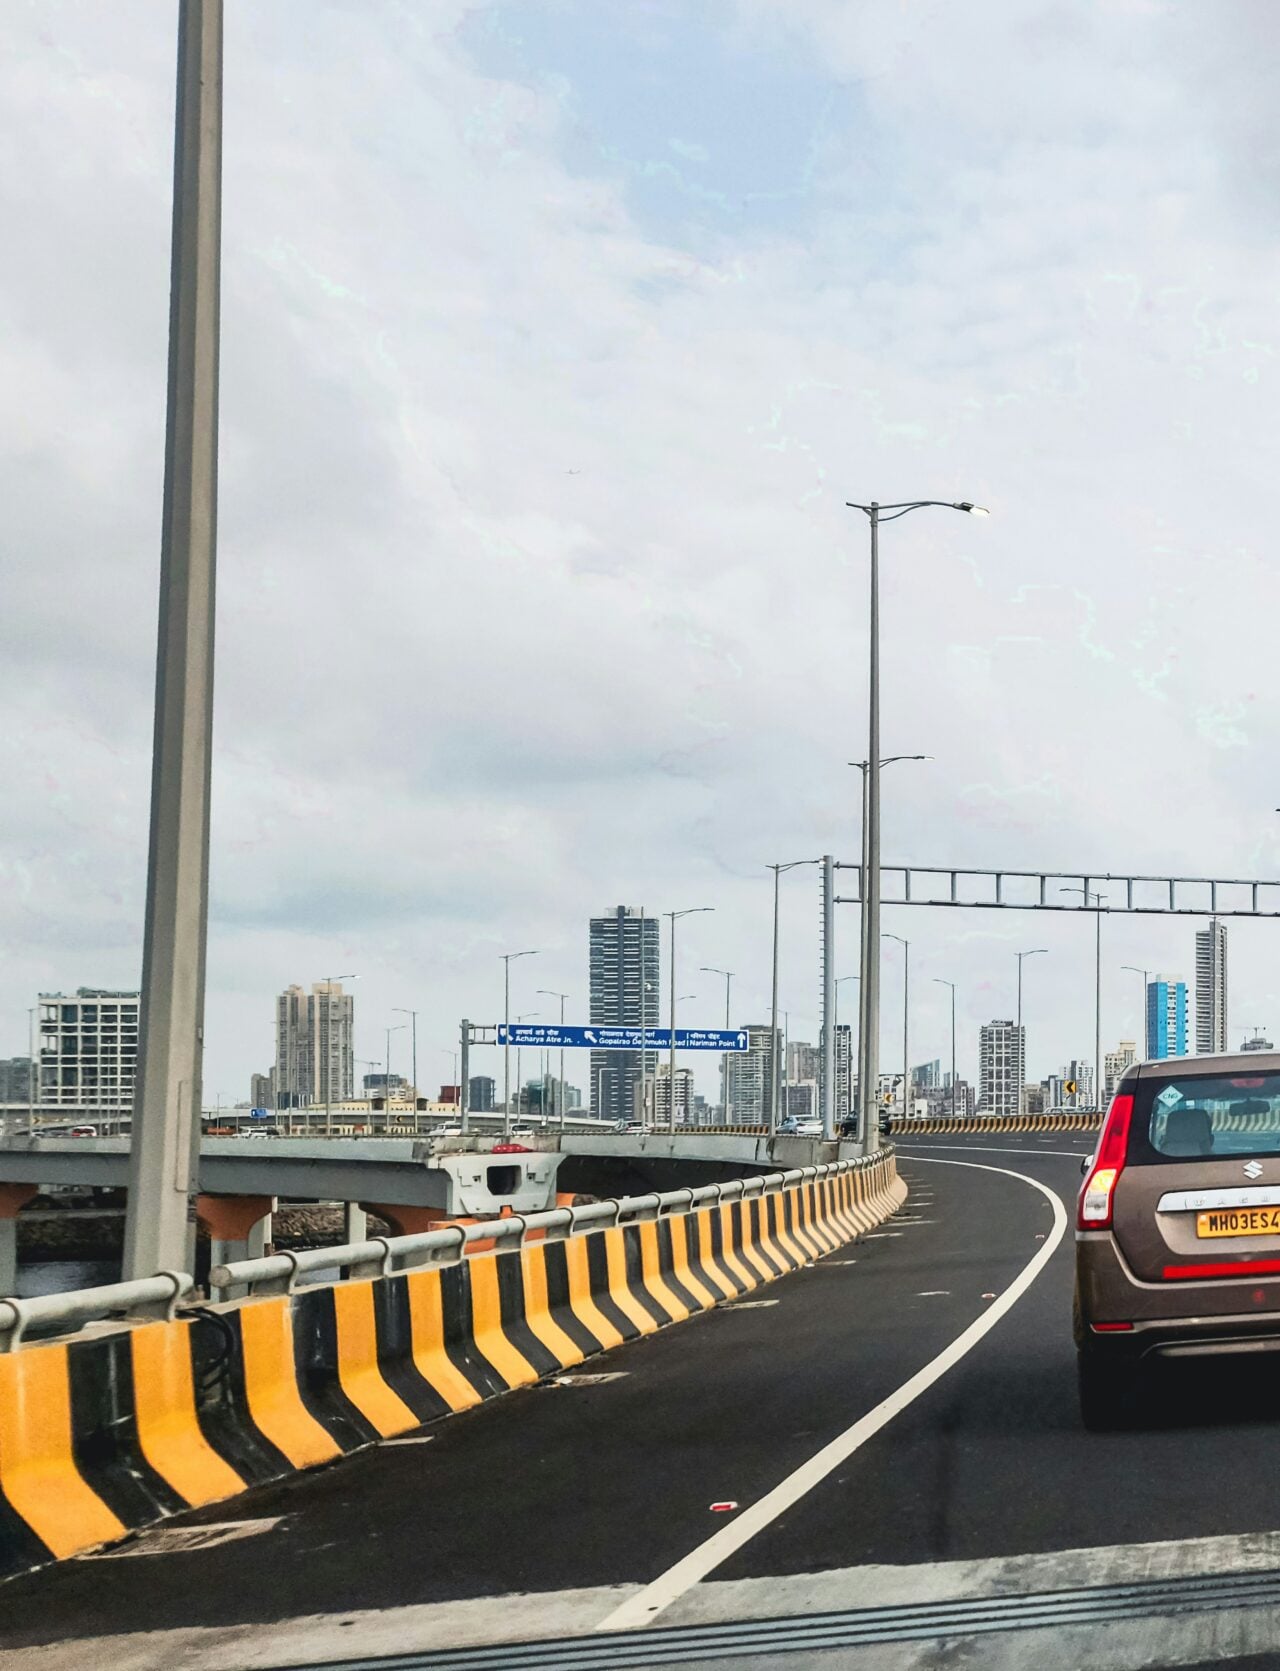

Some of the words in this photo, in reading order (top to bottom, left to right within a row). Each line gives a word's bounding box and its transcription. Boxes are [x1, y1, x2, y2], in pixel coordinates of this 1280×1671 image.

[515, 1035, 544, 1044] Acharya
[599, 1037, 631, 1045] Gopalrao
[690, 1039, 717, 1047] Nariman
